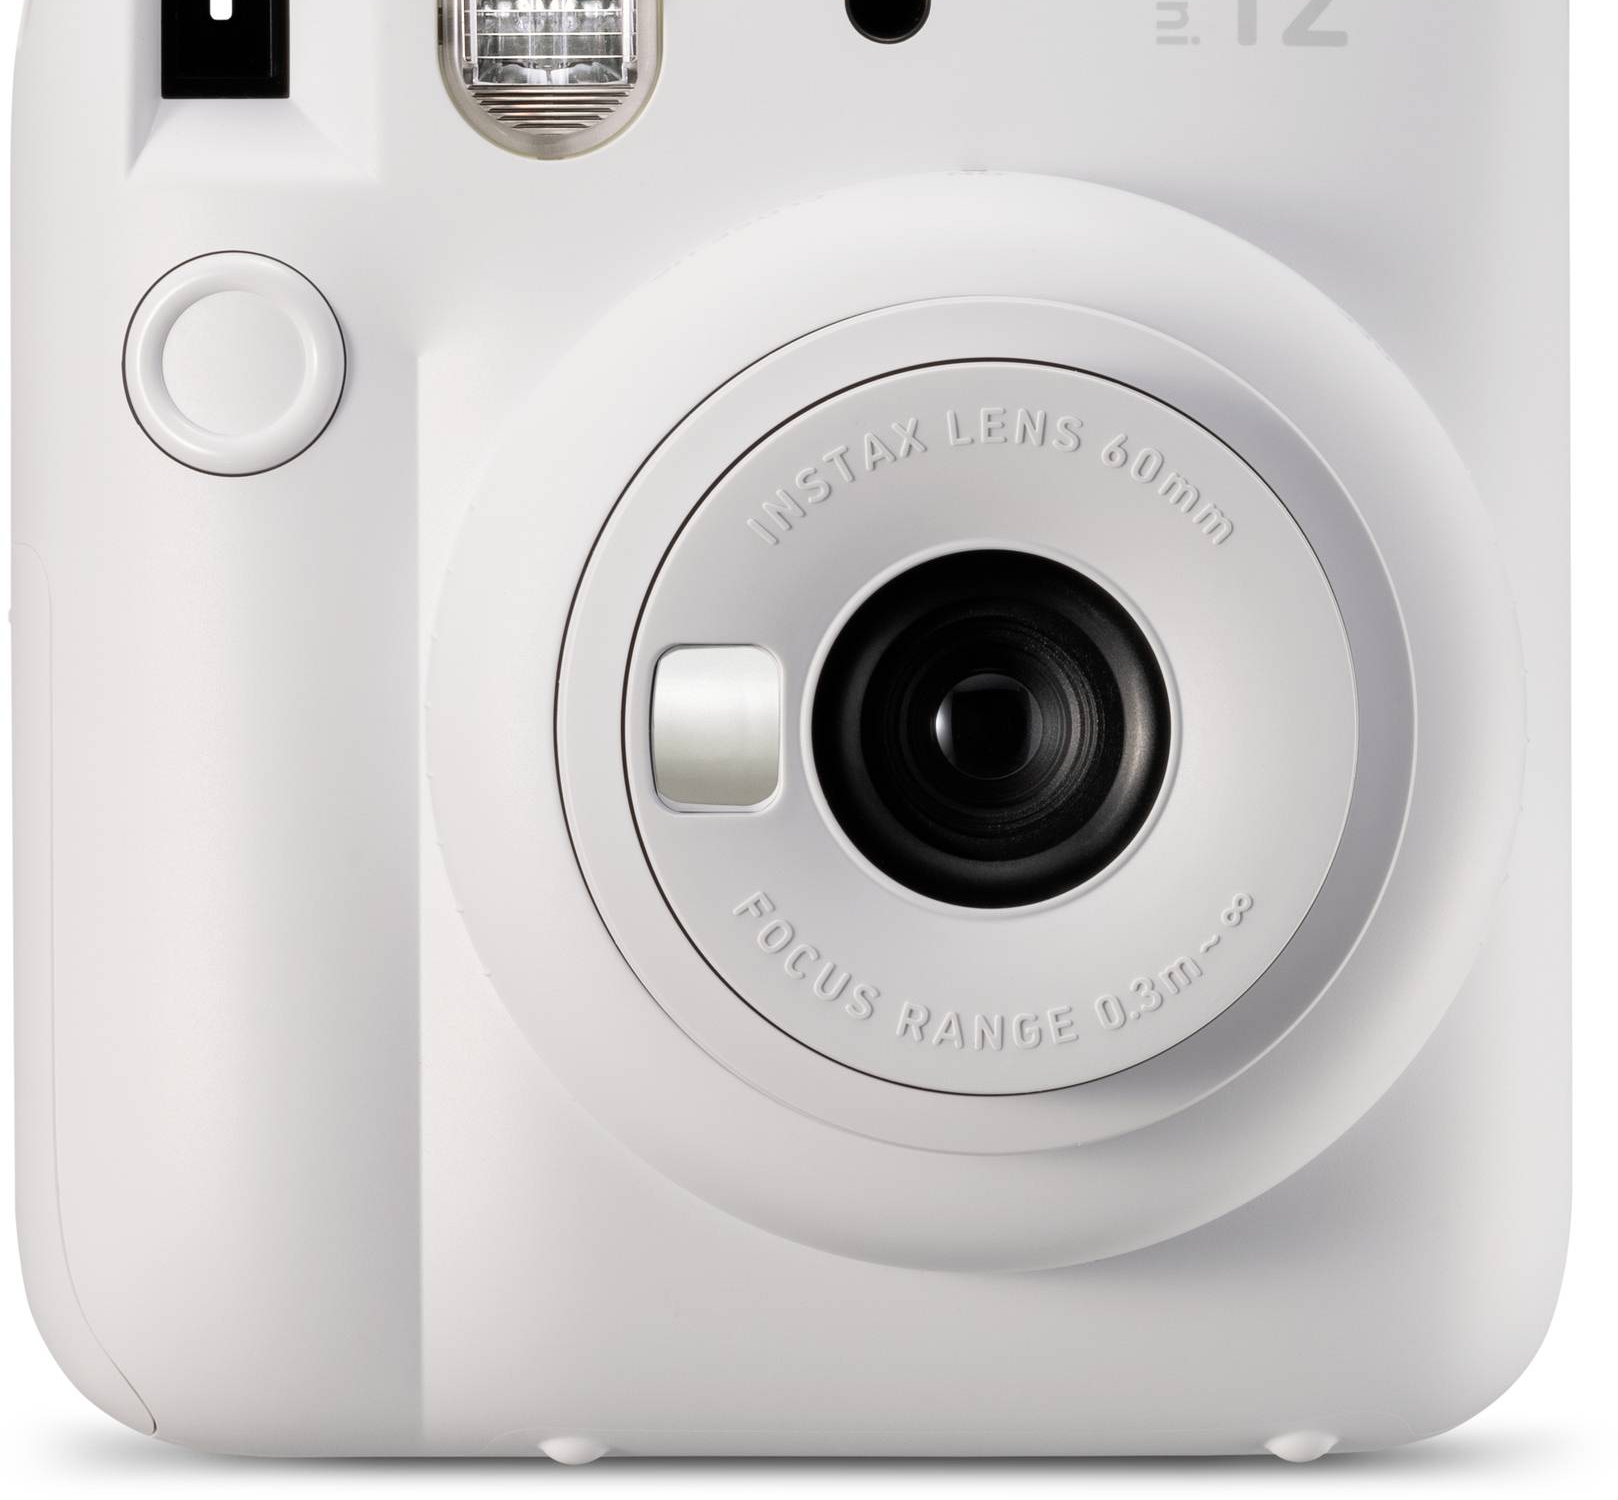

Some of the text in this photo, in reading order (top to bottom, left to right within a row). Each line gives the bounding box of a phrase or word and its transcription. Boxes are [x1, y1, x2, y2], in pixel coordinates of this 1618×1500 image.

[746, 406, 1235, 546] INSTAX LENS 60mm
[731, 890, 881, 1021] FOCUS
[895, 1000, 1080, 1051] RANGE
